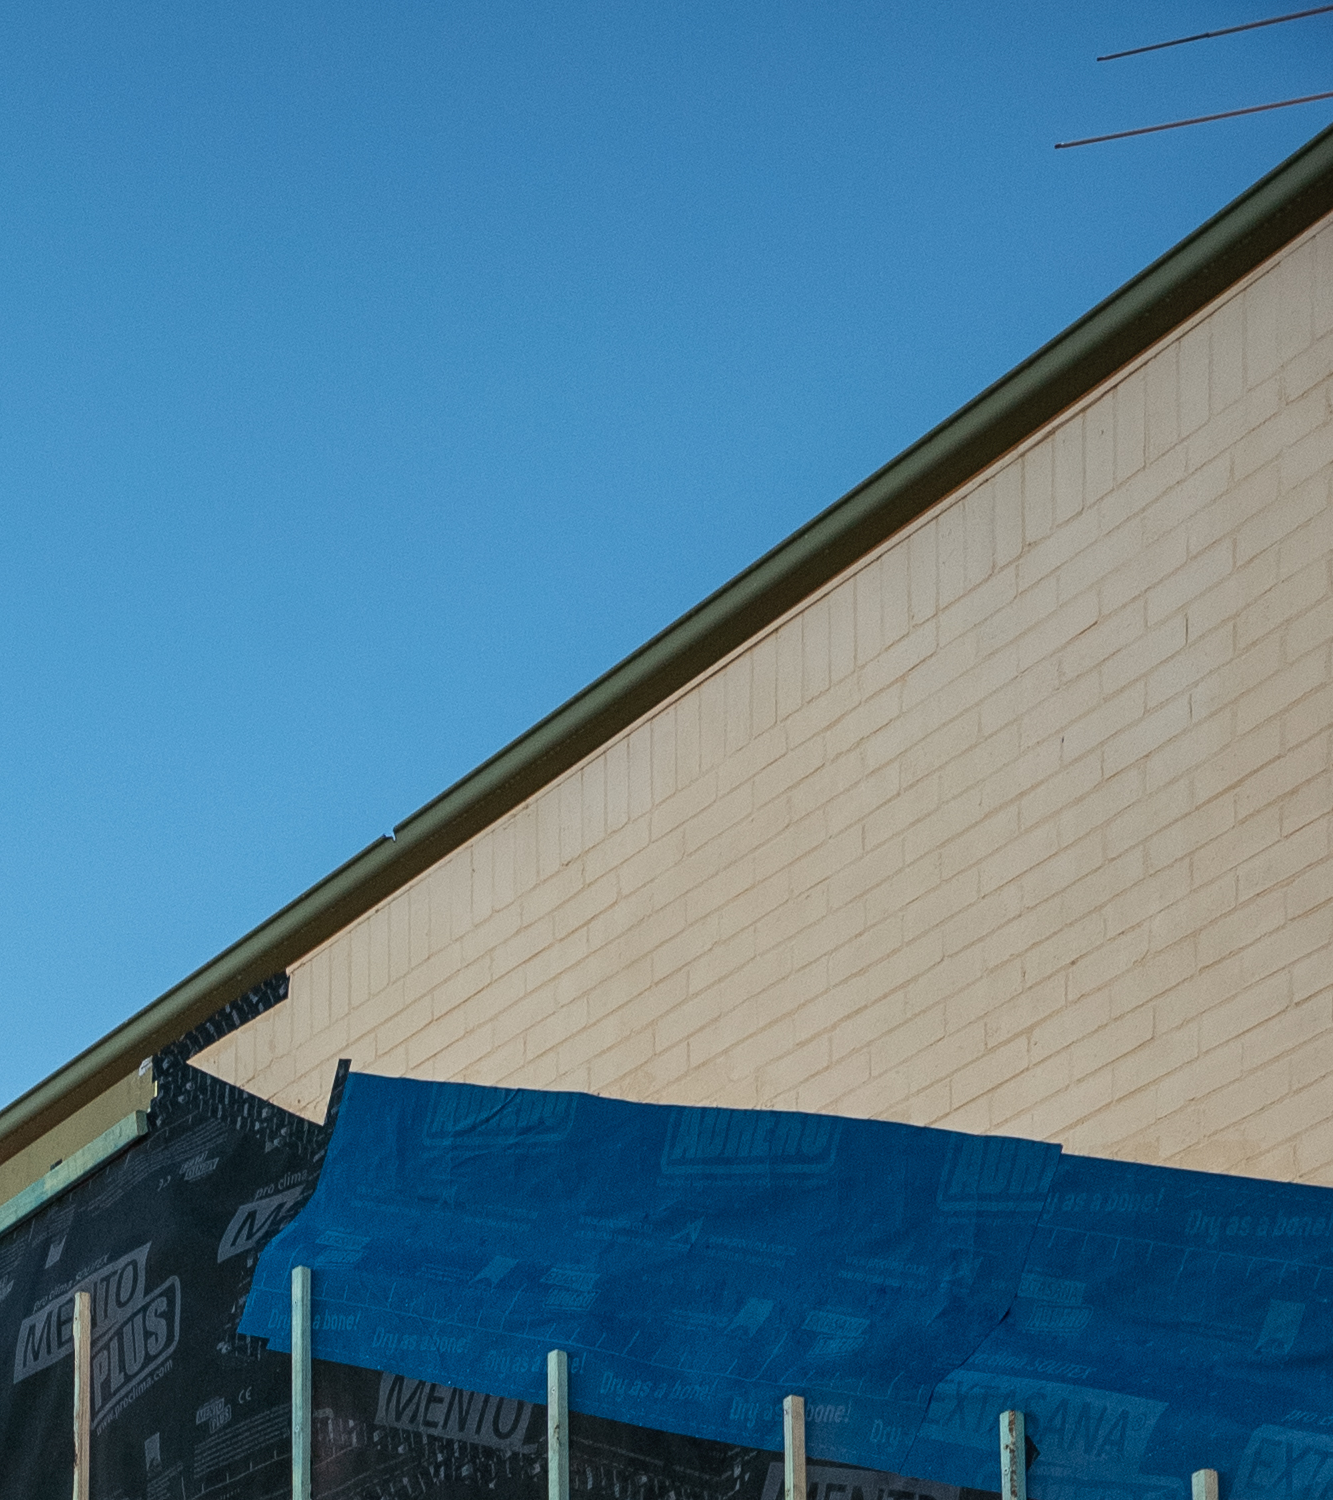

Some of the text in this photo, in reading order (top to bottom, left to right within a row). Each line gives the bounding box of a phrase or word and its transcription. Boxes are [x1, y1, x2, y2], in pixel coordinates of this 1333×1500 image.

[255, 1183, 276, 1203] pro
[1186, 1210, 1222, 1244] Dry
[1225, 1216, 1249, 1234] as
[93, 1297, 167, 1410] PLUS
[372, 1328, 399, 1350] Dry
[401, 1334, 417, 1349] as
[600, 1372, 626, 1402] Dry
[630, 1377, 649, 1397] as
[671, 1377, 716, 1400] bone!
[730, 1397, 758, 1426] Dry
[806, 1400, 850, 1424] bone!
[870, 1418, 898, 1448] Dry
